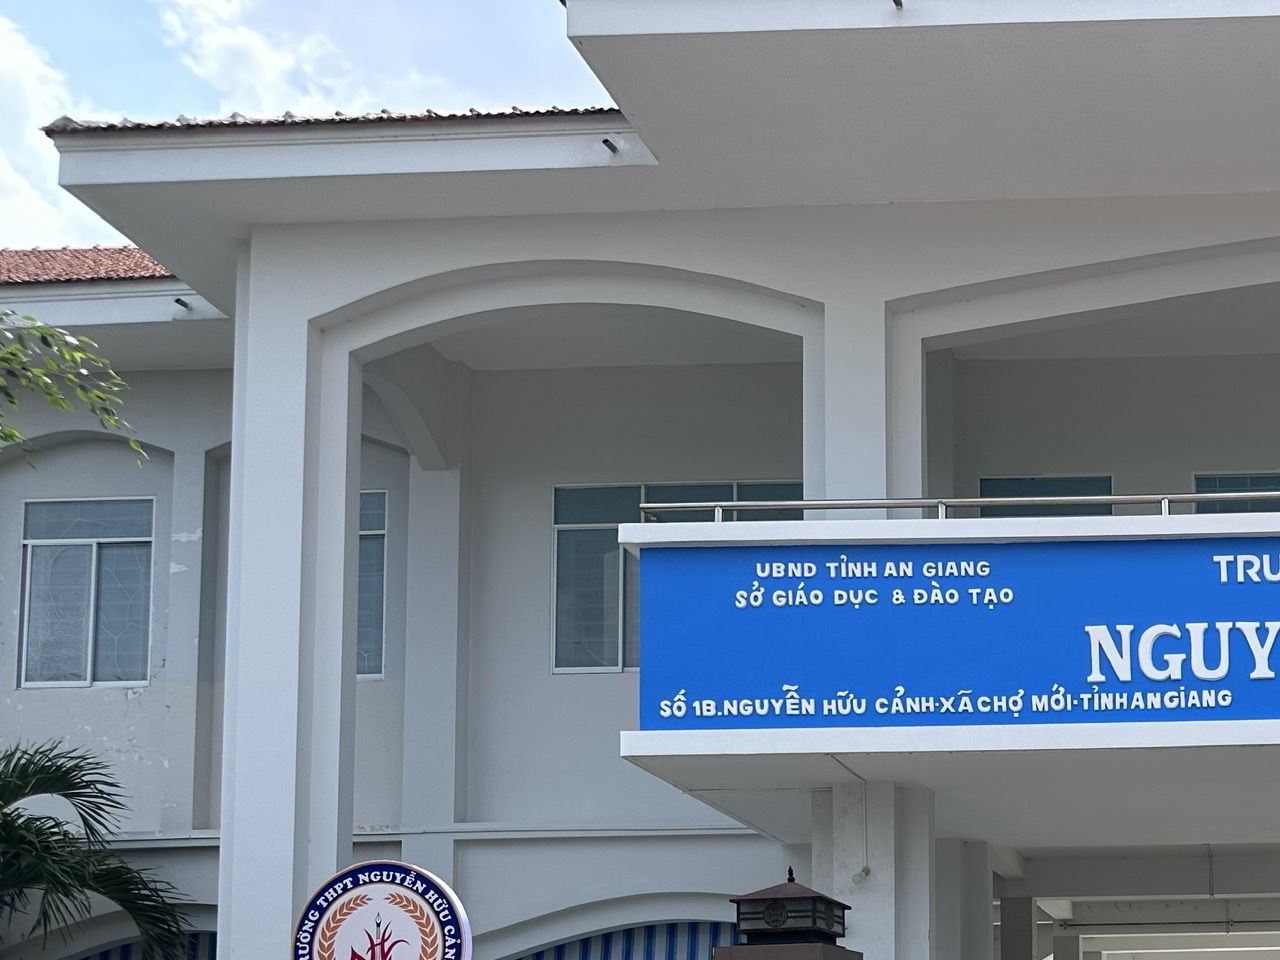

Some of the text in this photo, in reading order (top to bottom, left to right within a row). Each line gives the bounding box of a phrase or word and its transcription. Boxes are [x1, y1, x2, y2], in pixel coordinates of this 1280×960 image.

[756, 554, 991, 578] UBND TỈNH AN GIANG
[735, 581, 1014, 610] SỞ GIÁO DỤC & ĐÀO TẠO
[659, 689, 687, 718] SỐ
[822, 690, 867, 716] HỮU
[317, 877, 353, 909] THPT
[357, 871, 427, 893] NGUYỄN
[424, 889, 452, 922] HỮU
